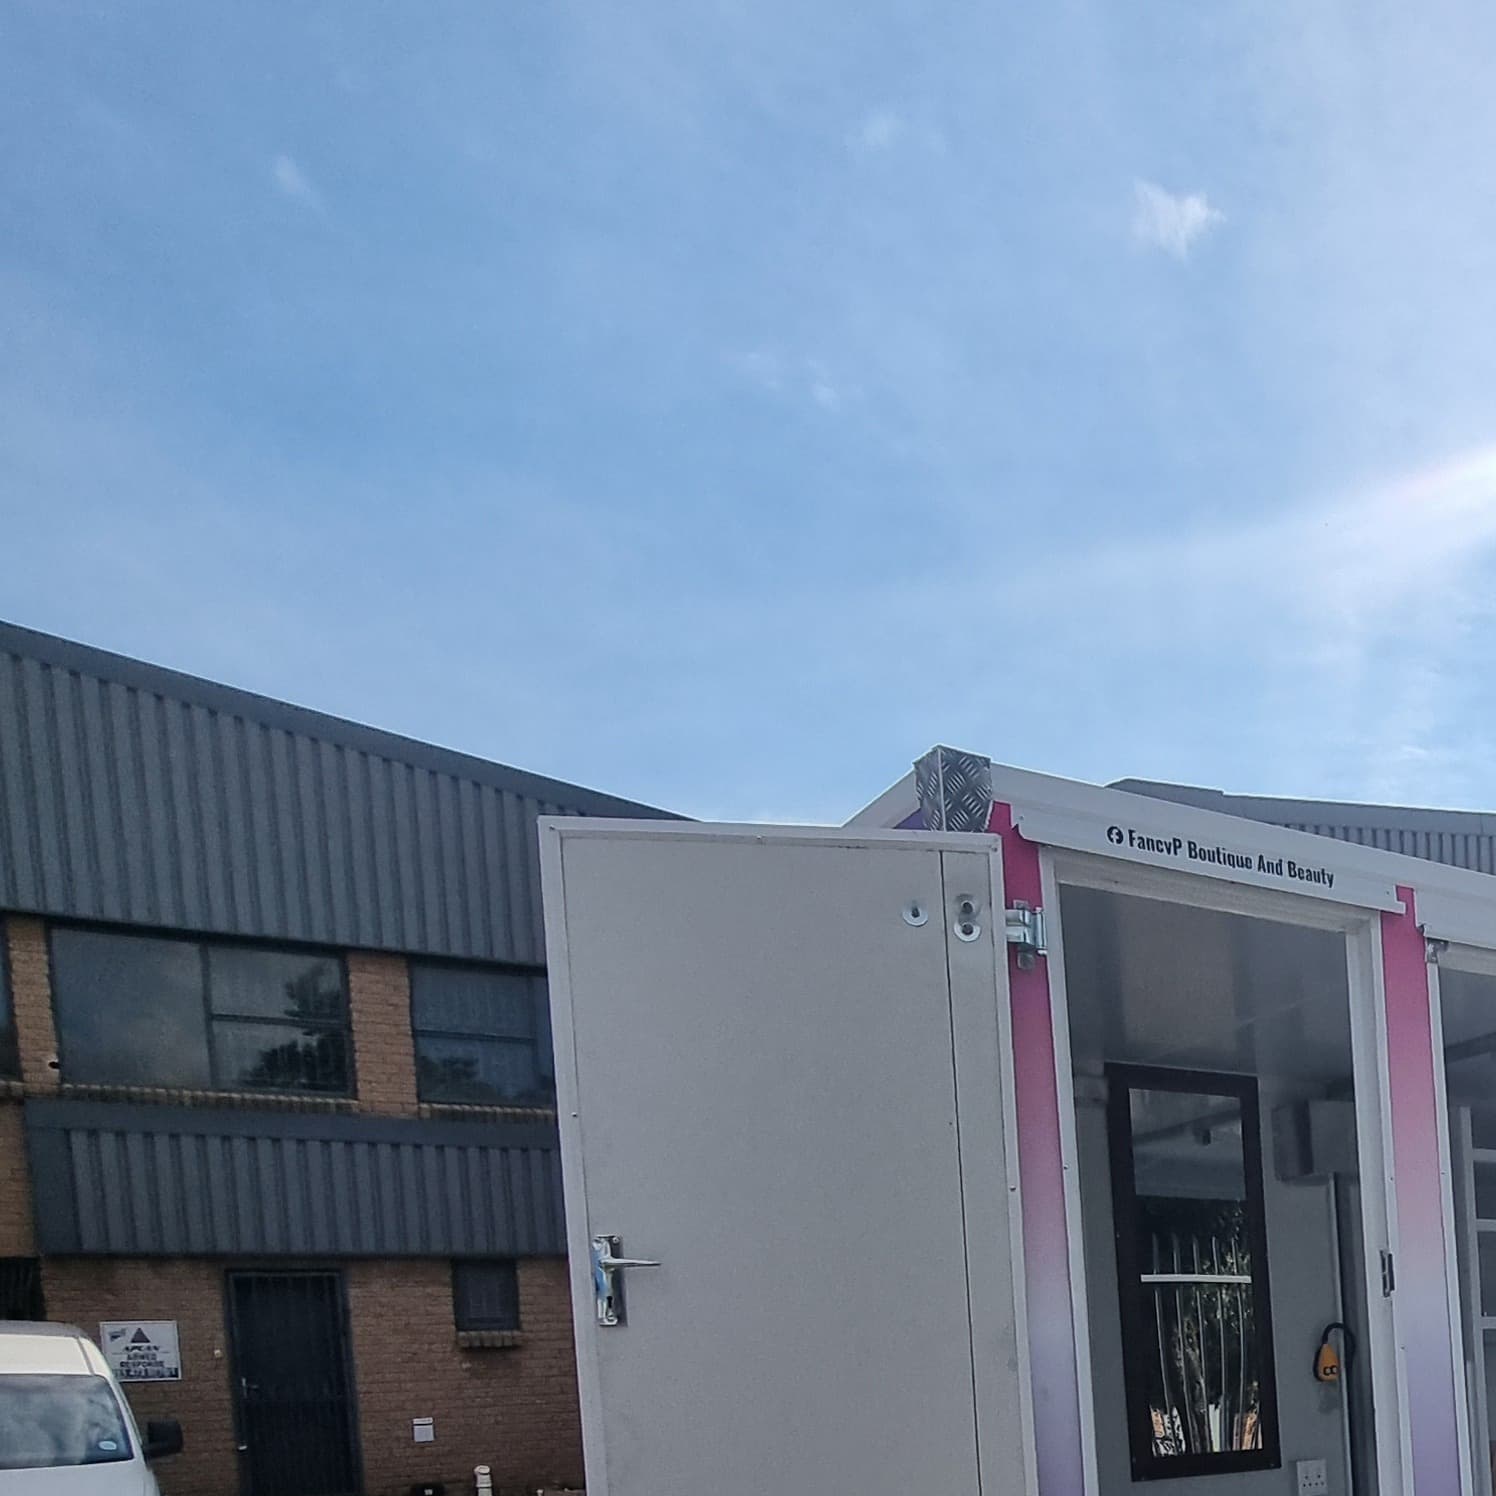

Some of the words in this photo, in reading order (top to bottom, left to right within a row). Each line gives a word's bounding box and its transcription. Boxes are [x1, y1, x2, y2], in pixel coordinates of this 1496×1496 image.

[1187, 840, 1253, 869] Boutique
[1257, 854, 1283, 876] And
[1288, 861, 1335, 888] Beauty
